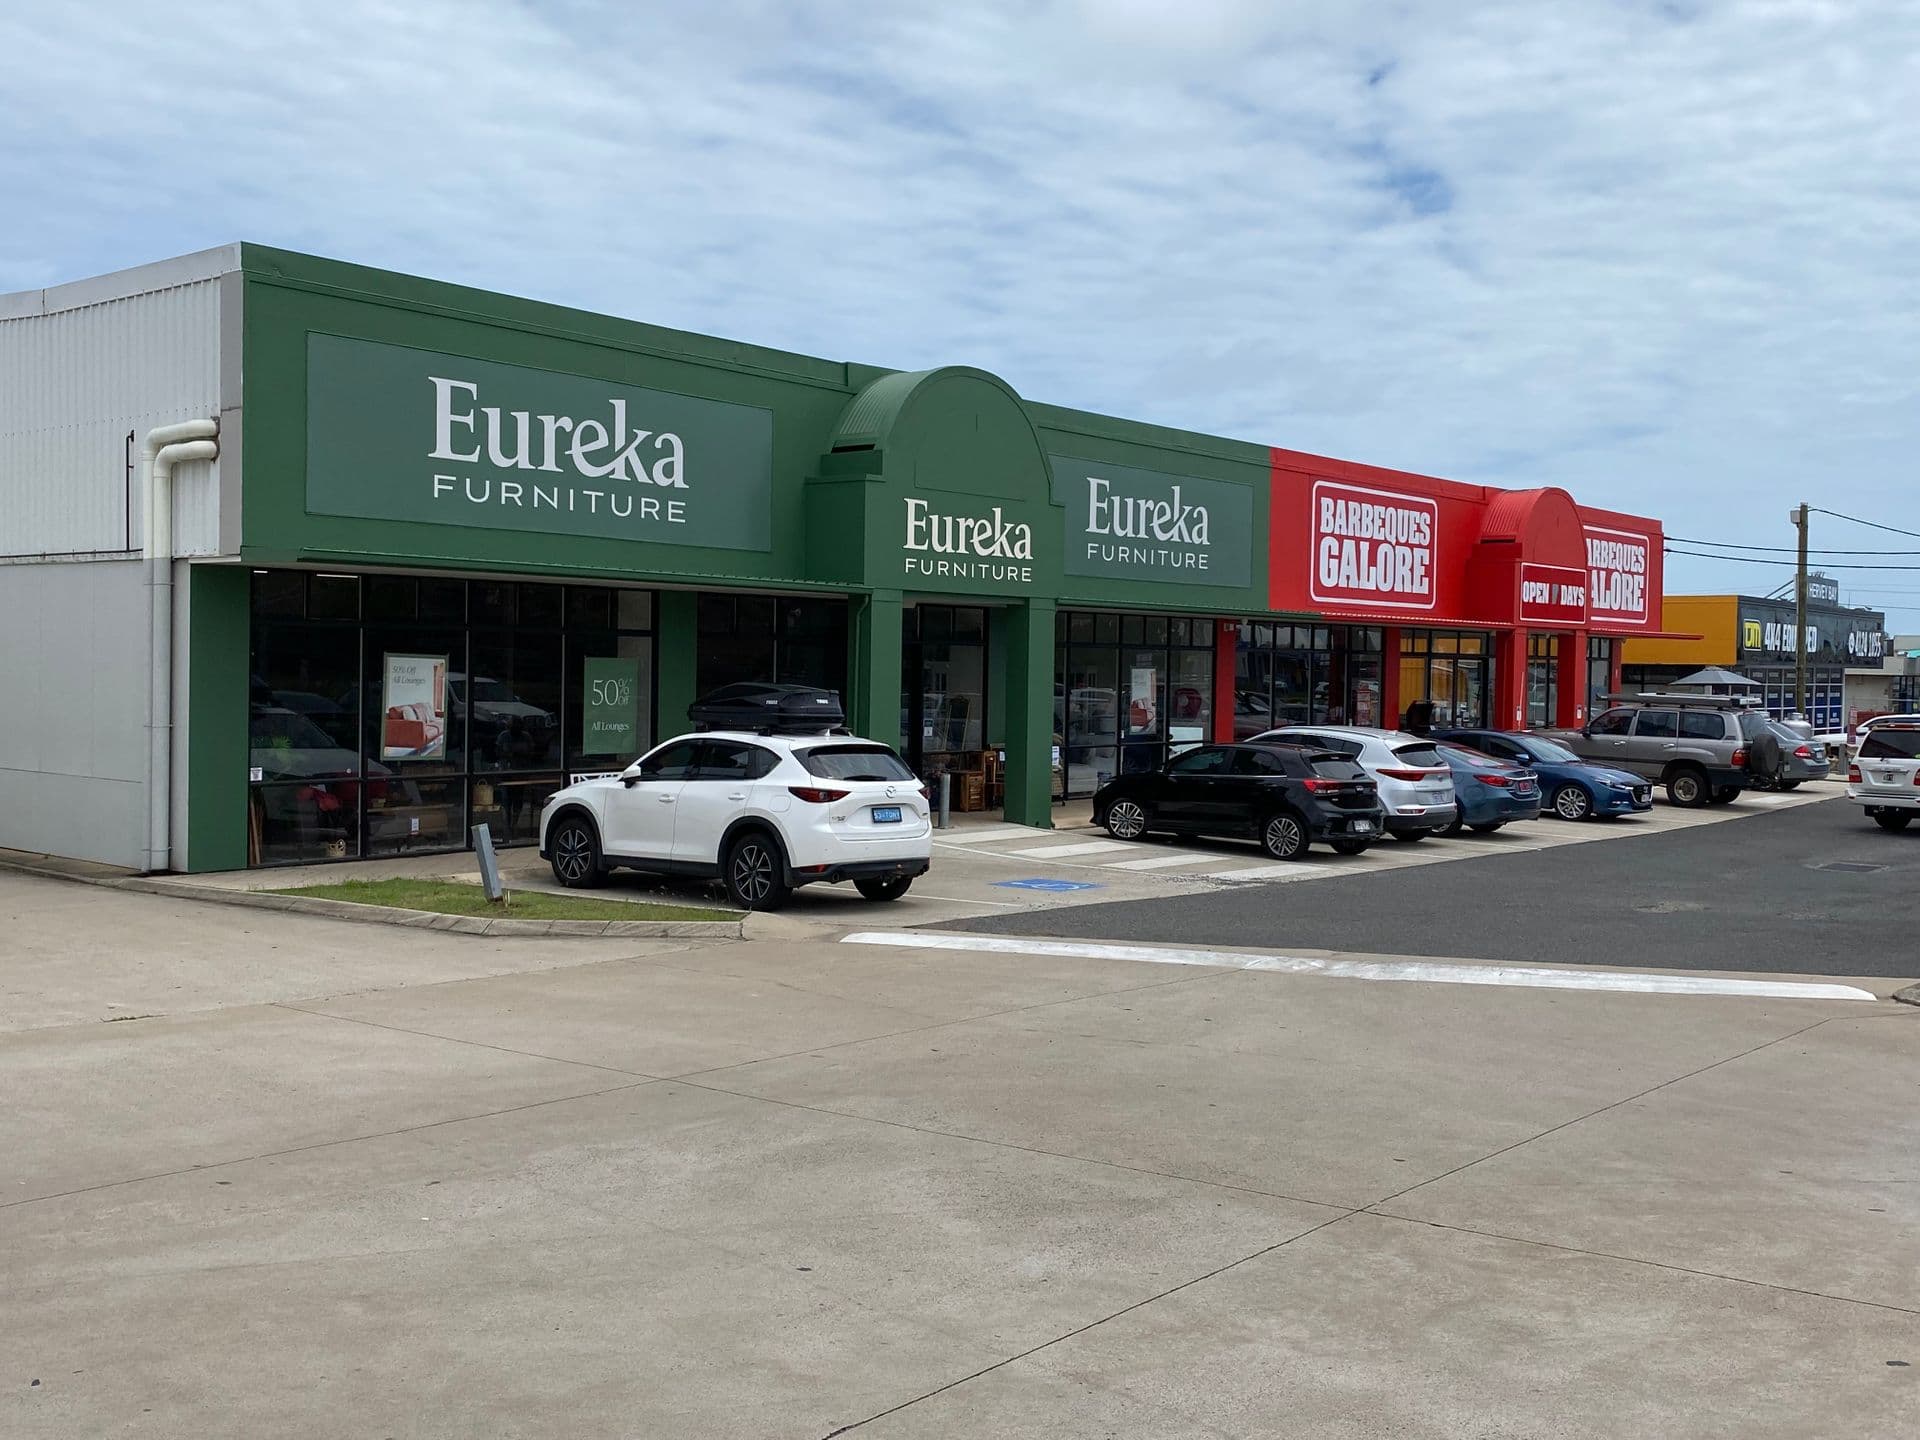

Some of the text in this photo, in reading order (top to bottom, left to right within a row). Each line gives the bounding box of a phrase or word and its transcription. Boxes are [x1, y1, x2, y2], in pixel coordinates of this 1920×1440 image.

[428, 376, 689, 488] Eureka
[433, 474, 686, 523] FURNITURE
[1086, 477, 1210, 545] Eureka
[903, 497, 1033, 560] Eureka
[1320, 497, 1431, 546] BARBEQUES
[905, 558, 1032, 582] FURNITURE
[1087, 544, 1209, 570] FURNITURE
[1319, 535, 1430, 595] GALORE
[1586, 538, 1645, 573] ARBEQUES
[1523, 580, 1550, 605] OPEN
[1560, 584, 1585, 607] DAYS
[1591, 570, 1644, 612] ALORE
[591, 721, 630, 733] All Lounges
